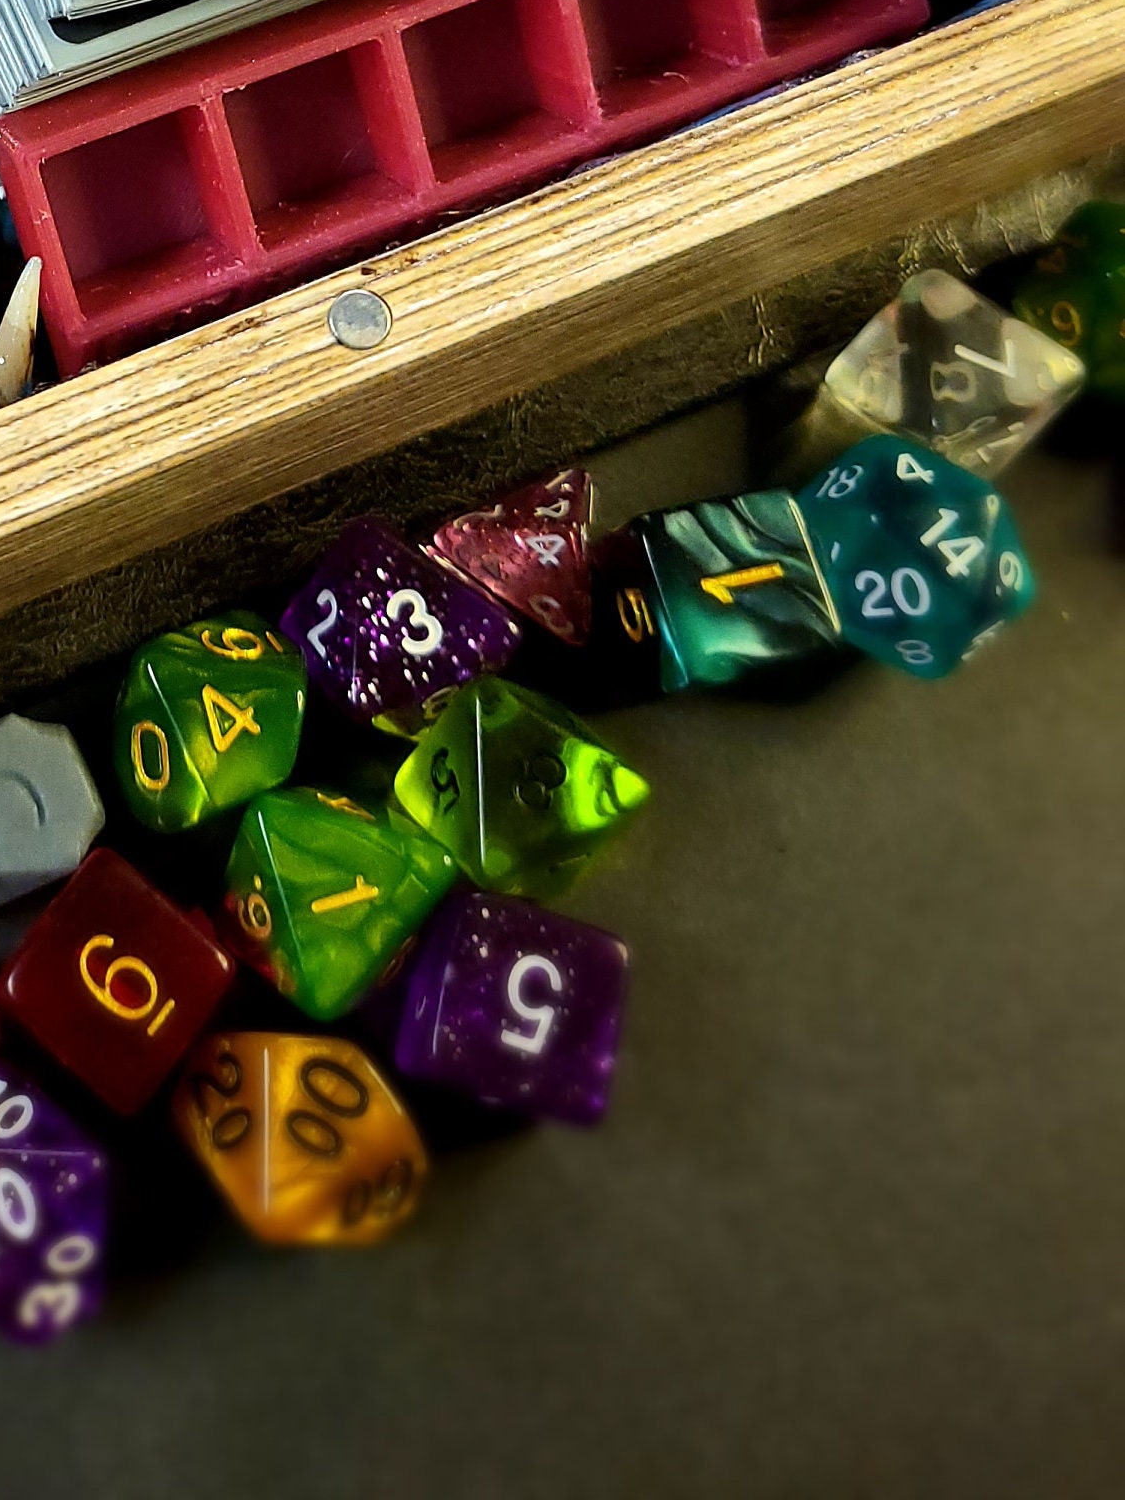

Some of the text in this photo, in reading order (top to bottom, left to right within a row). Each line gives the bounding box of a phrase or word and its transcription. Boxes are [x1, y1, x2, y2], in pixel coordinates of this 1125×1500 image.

[815, 463, 866, 500] 18
[895, 452, 936, 486] 4
[523, 532, 567, 569] 4
[918, 506, 986, 579] 14
[699, 562, 785, 605] 1
[853, 566, 933, 619] 20
[305, 587, 339, 660] 2
[385, 587, 445, 657] 3
[893, 638, 936, 666] 8
[201, 683, 263, 754] 4
[130, 719, 173, 792] 0
[310, 873, 381, 916] 1
[500, 953, 563, 1056] 5
